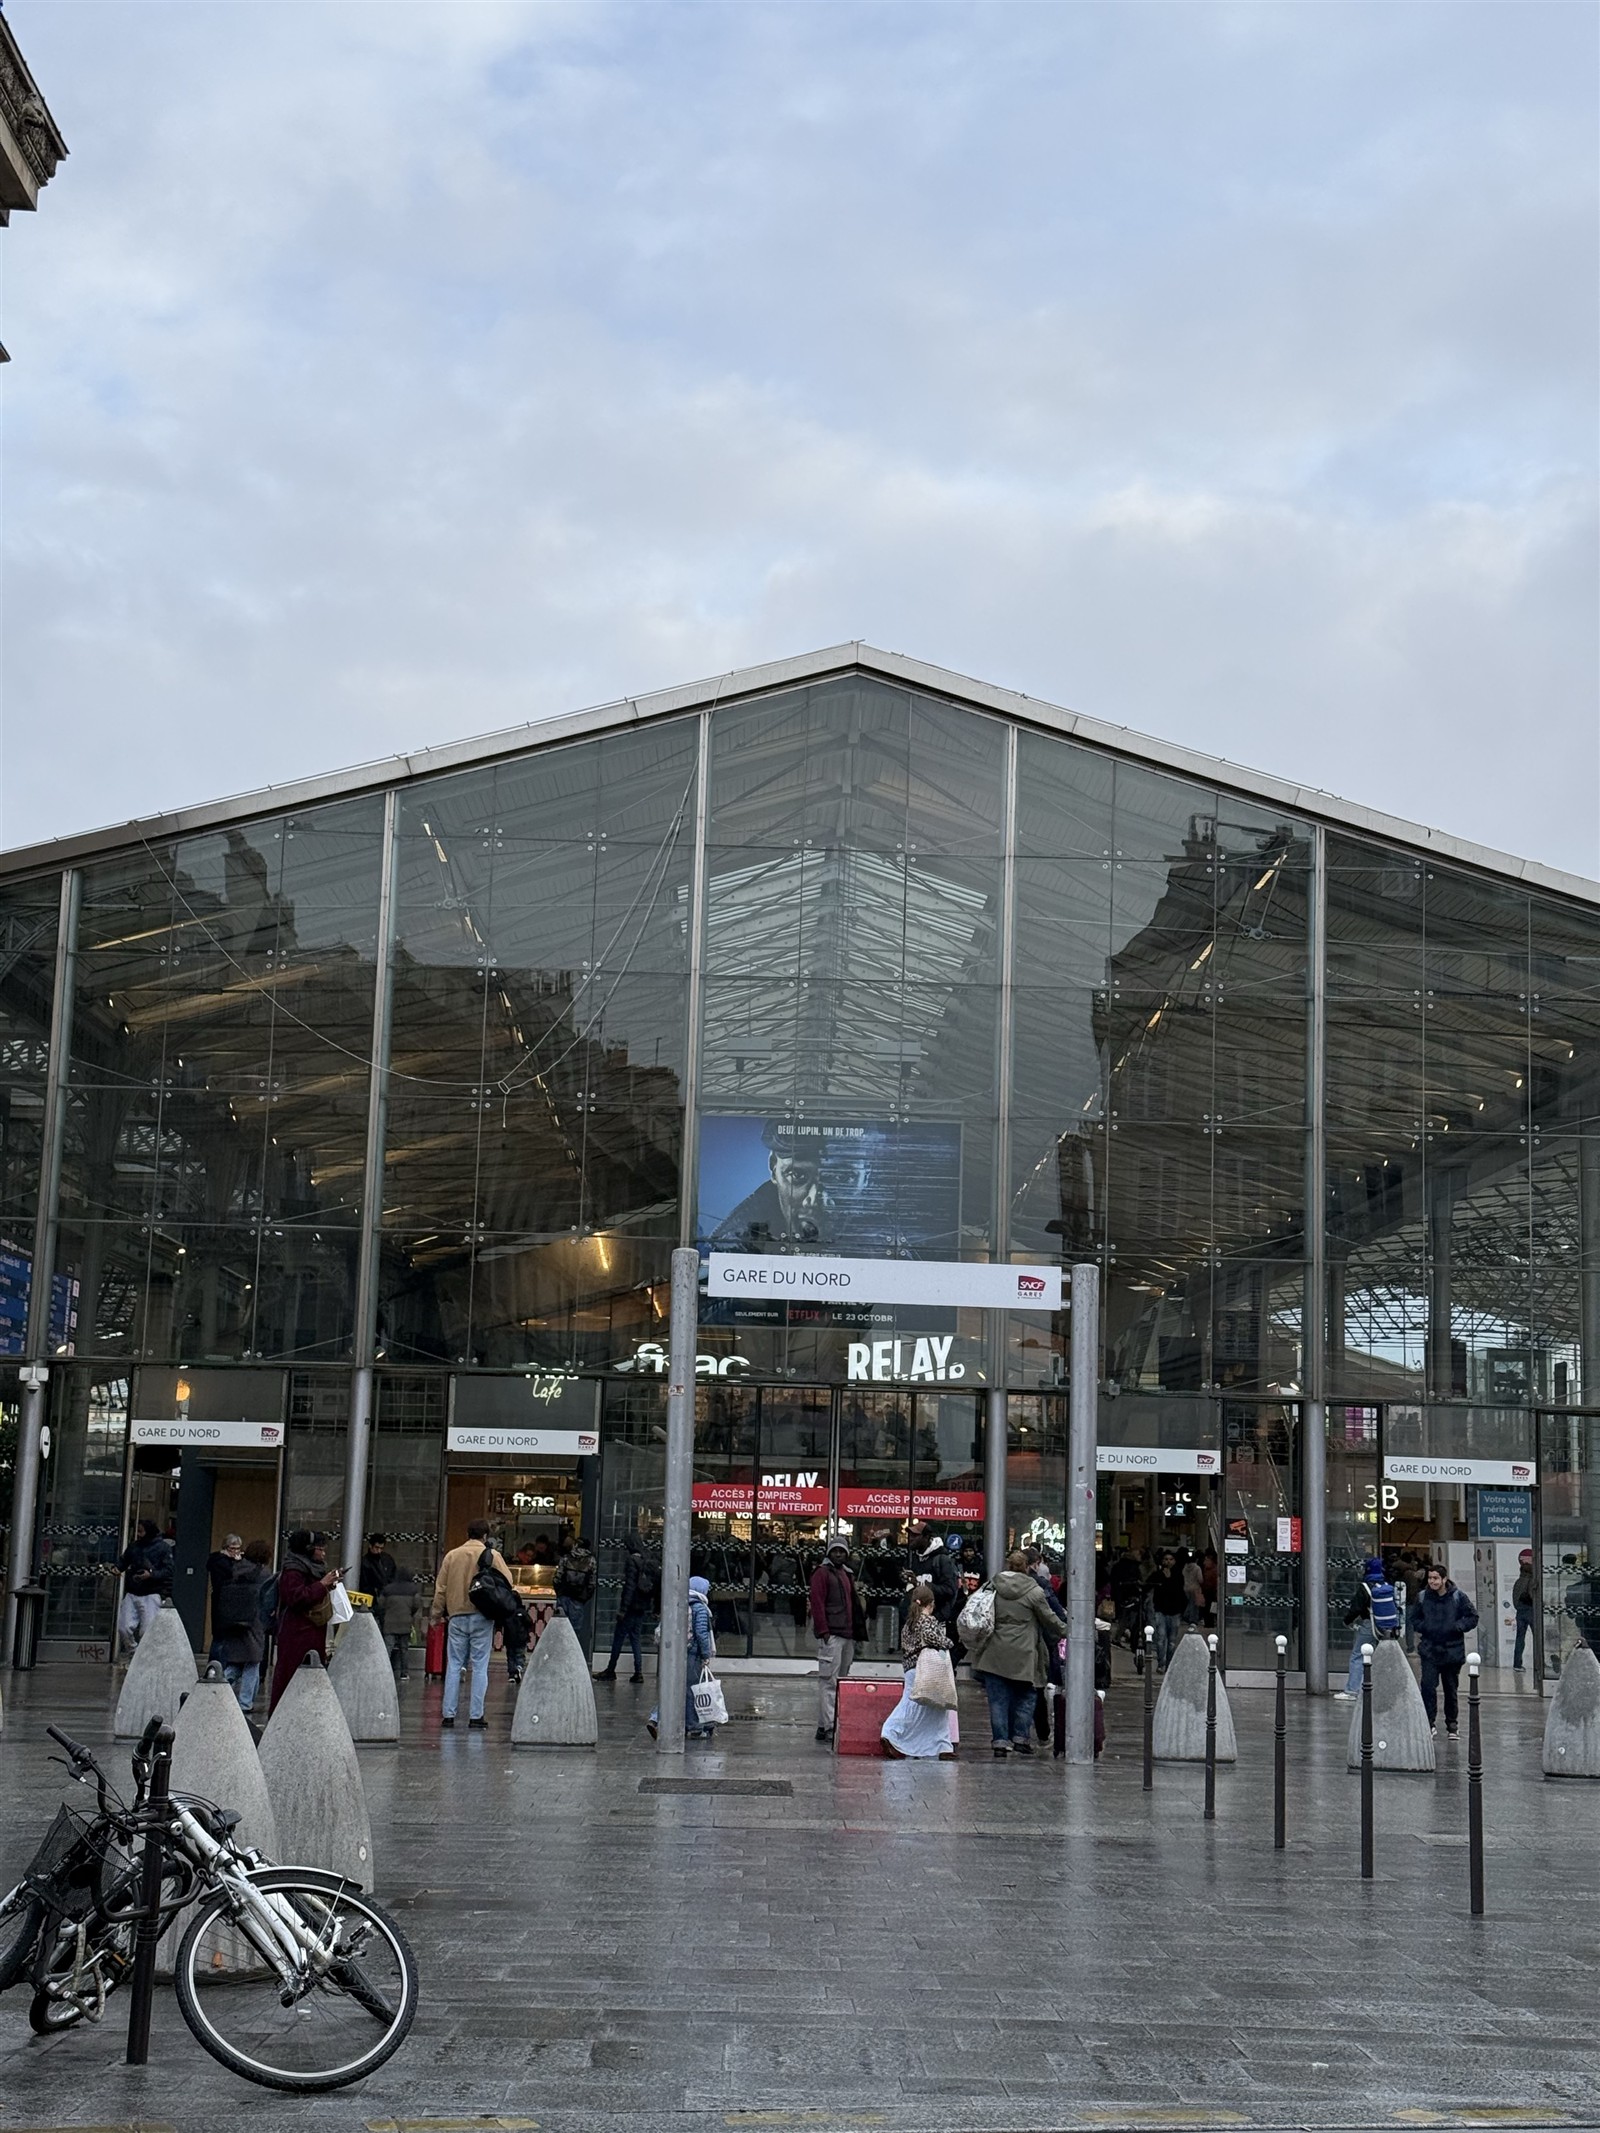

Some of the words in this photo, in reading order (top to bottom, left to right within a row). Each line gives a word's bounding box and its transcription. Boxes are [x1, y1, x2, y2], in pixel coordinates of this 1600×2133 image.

[798, 1126, 821, 1136] LUPIN.
[822, 1127, 833, 1136] UN
[835, 1127, 845, 1137] DE
[846, 1128, 866, 1138] TROP.
[723, 1268, 767, 1283] GARE
[773, 1271, 796, 1284] DU
[802, 1272, 851, 1287] NORD
[1019, 1281, 1045, 1290] SNCF
[786, 1309, 819, 1321] ETFLIX
[832, 1312, 842, 1320] LE
[845, 1313, 857, 1321] 23
[857, 1313, 897, 1322] OCTOBR
[138, 1427, 167, 1437] GARE
[170, 1428, 186, 1437] DU
[189, 1428, 221, 1438] NORD
[457, 1435, 486, 1444] GARE
[489, 1436, 504, 1445] DU
[507, 1436, 538, 1446] NORD
[1108, 1454, 1123, 1463] DU
[1126, 1455, 1158, 1465] NORD
[1390, 1464, 1419, 1473] GARE
[1422, 1465, 1437, 1474] DU
[1440, 1466, 1472, 1476] NORD
[512, 1492, 555, 1507] fnac
[711, 1488, 745, 1498] ACCÈS
[747, 1490, 802, 1500] POMPIERS
[867, 1492, 901, 1503] ACCÈS
[904, 1495, 958, 1505] POMPIERS
[1363, 1485, 1399, 1510] 3B
[1483, 1495, 1506, 1503] Votre
[1508, 1496, 1526, 1504] vélo
[691, 1500, 776, 1510] STATIONNEMENT
[778, 1502, 823, 1512] INTERDIT
[846, 1504, 932, 1515] STATIONNEMENT
[934, 1507, 979, 1517] INTERDIT
[1482, 1505, 1509, 1513] mérite
[1487, 1515, 1510, 1524] place
[1511, 1515, 1523, 1523] de
[1491, 1525, 1514, 1533] choix
